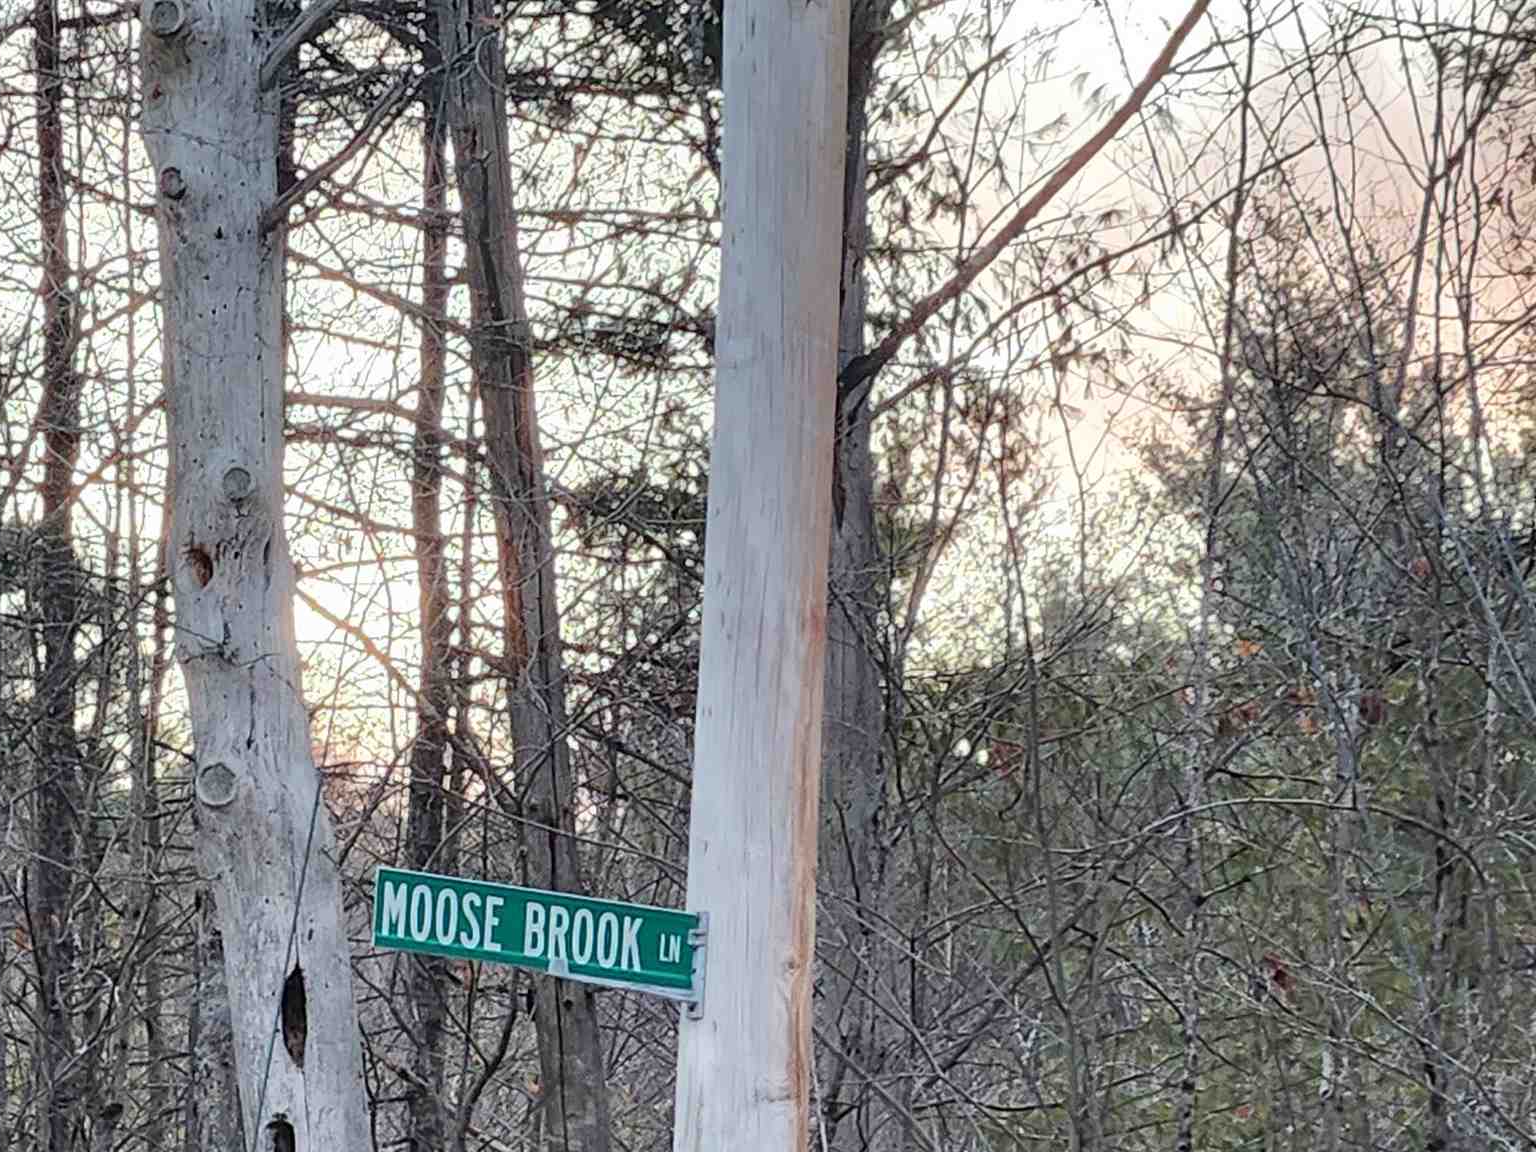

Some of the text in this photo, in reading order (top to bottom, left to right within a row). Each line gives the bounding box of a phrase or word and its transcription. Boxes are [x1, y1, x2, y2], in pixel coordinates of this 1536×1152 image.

[381, 881, 681, 972] MOOSE BROOK LN
